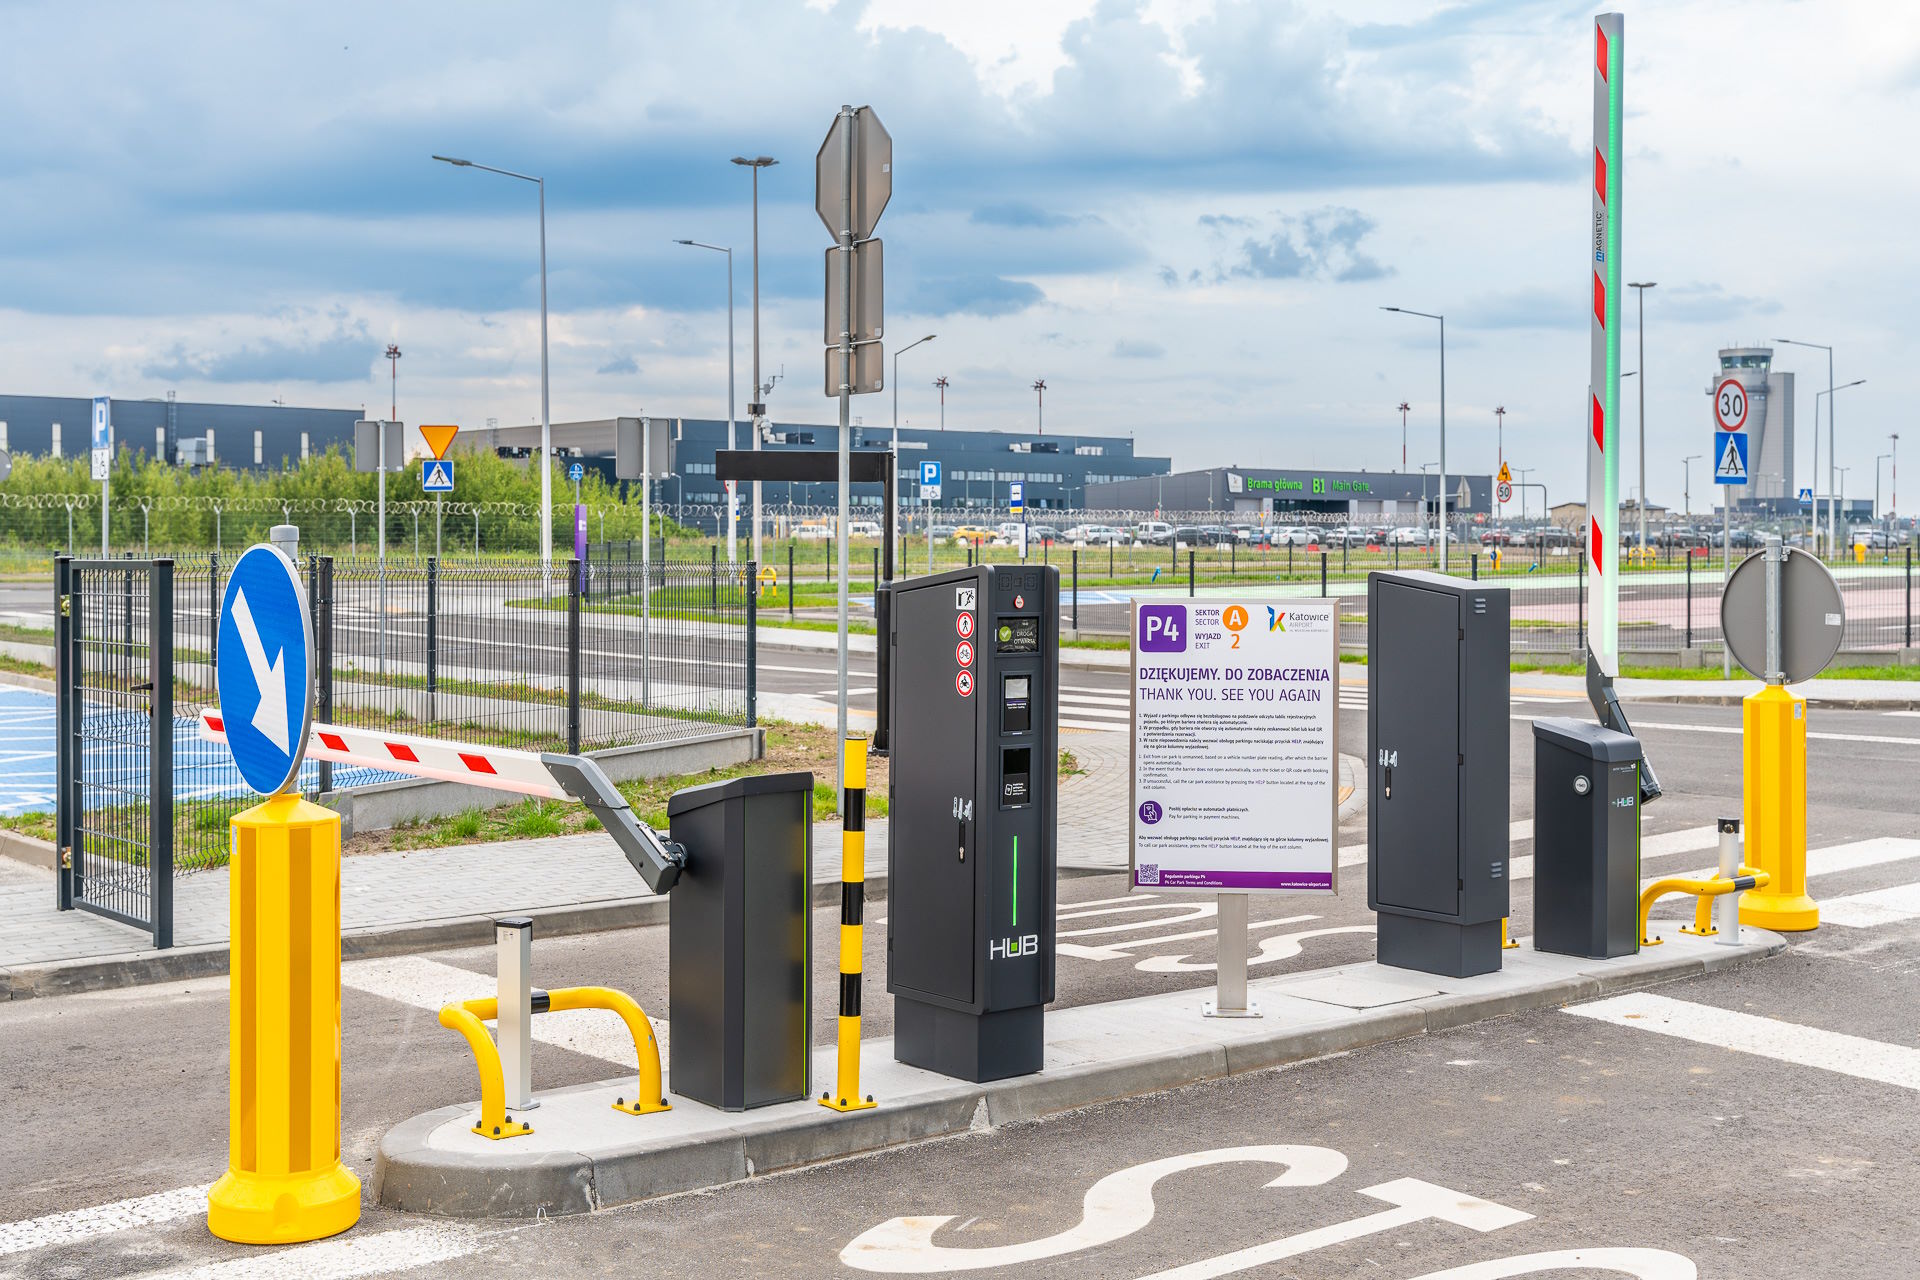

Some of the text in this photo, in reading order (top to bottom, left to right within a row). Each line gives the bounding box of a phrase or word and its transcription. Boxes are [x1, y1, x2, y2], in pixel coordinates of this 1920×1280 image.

[1721, 393, 1742, 417] 30
[95, 402, 106, 442] P
[924, 464, 937, 483] P
[1247, 477, 1369, 494] Brama główna B1 Main Gate
[1499, 486, 1509, 498] 50
[1195, 618, 1219, 626] SECTOR
[1229, 609, 1242, 626] A
[1289, 612, 1329, 621] Katowice
[1146, 615, 1179, 642] P4
[1231, 634, 1240, 649] 2
[1139, 667, 1330, 683] DZIĘKUJEMY. DO ZOBACZENIA
[1139, 687, 1321, 702] THANK YOU. SEE YOU AGAIN
[1616, 796, 1634, 808] HUB
[990, 934, 1038, 960] HUB
